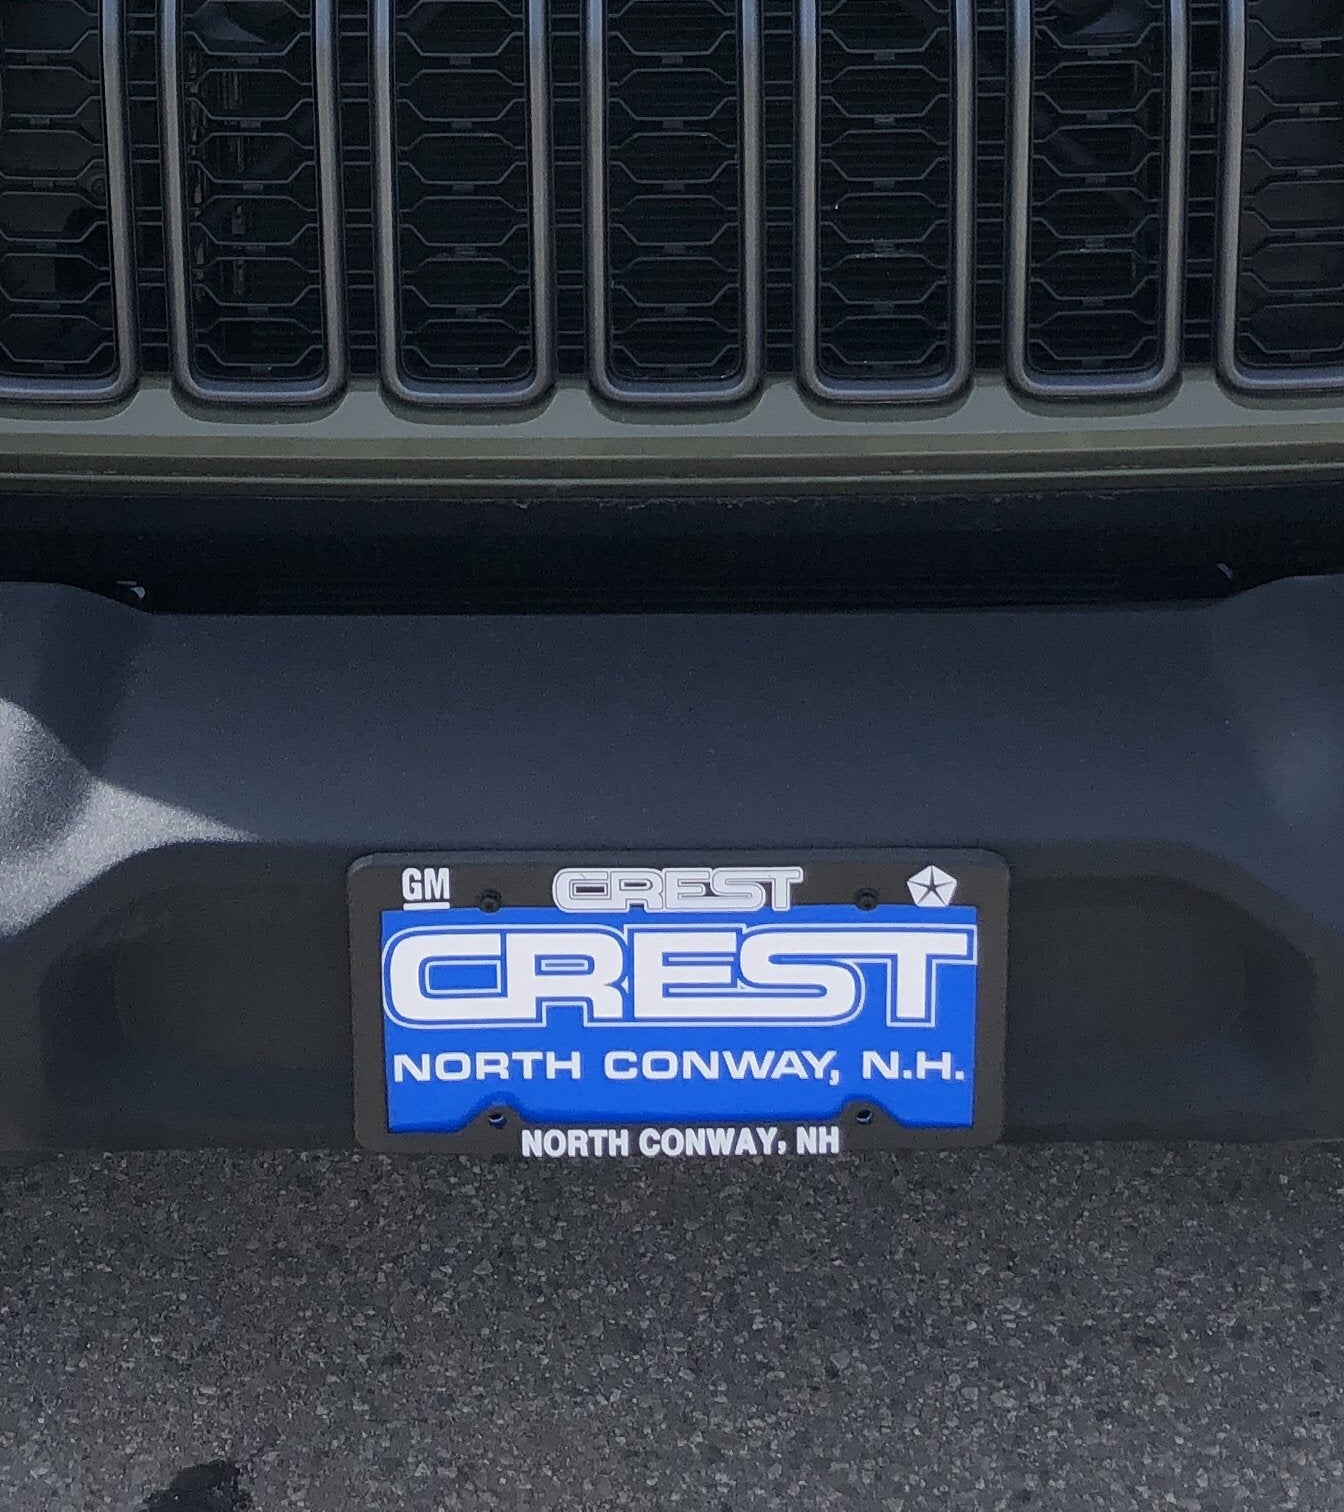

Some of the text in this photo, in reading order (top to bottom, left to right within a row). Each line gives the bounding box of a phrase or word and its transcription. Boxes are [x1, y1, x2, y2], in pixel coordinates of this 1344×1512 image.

[402, 867, 450, 901] GM
[552, 866, 804, 913] CREST
[382, 923, 978, 1030] CREST
[393, 1050, 966, 1086] NORTH CONWAY, N.H.
[521, 1125, 840, 1159] NORTH CONWAY, NH
